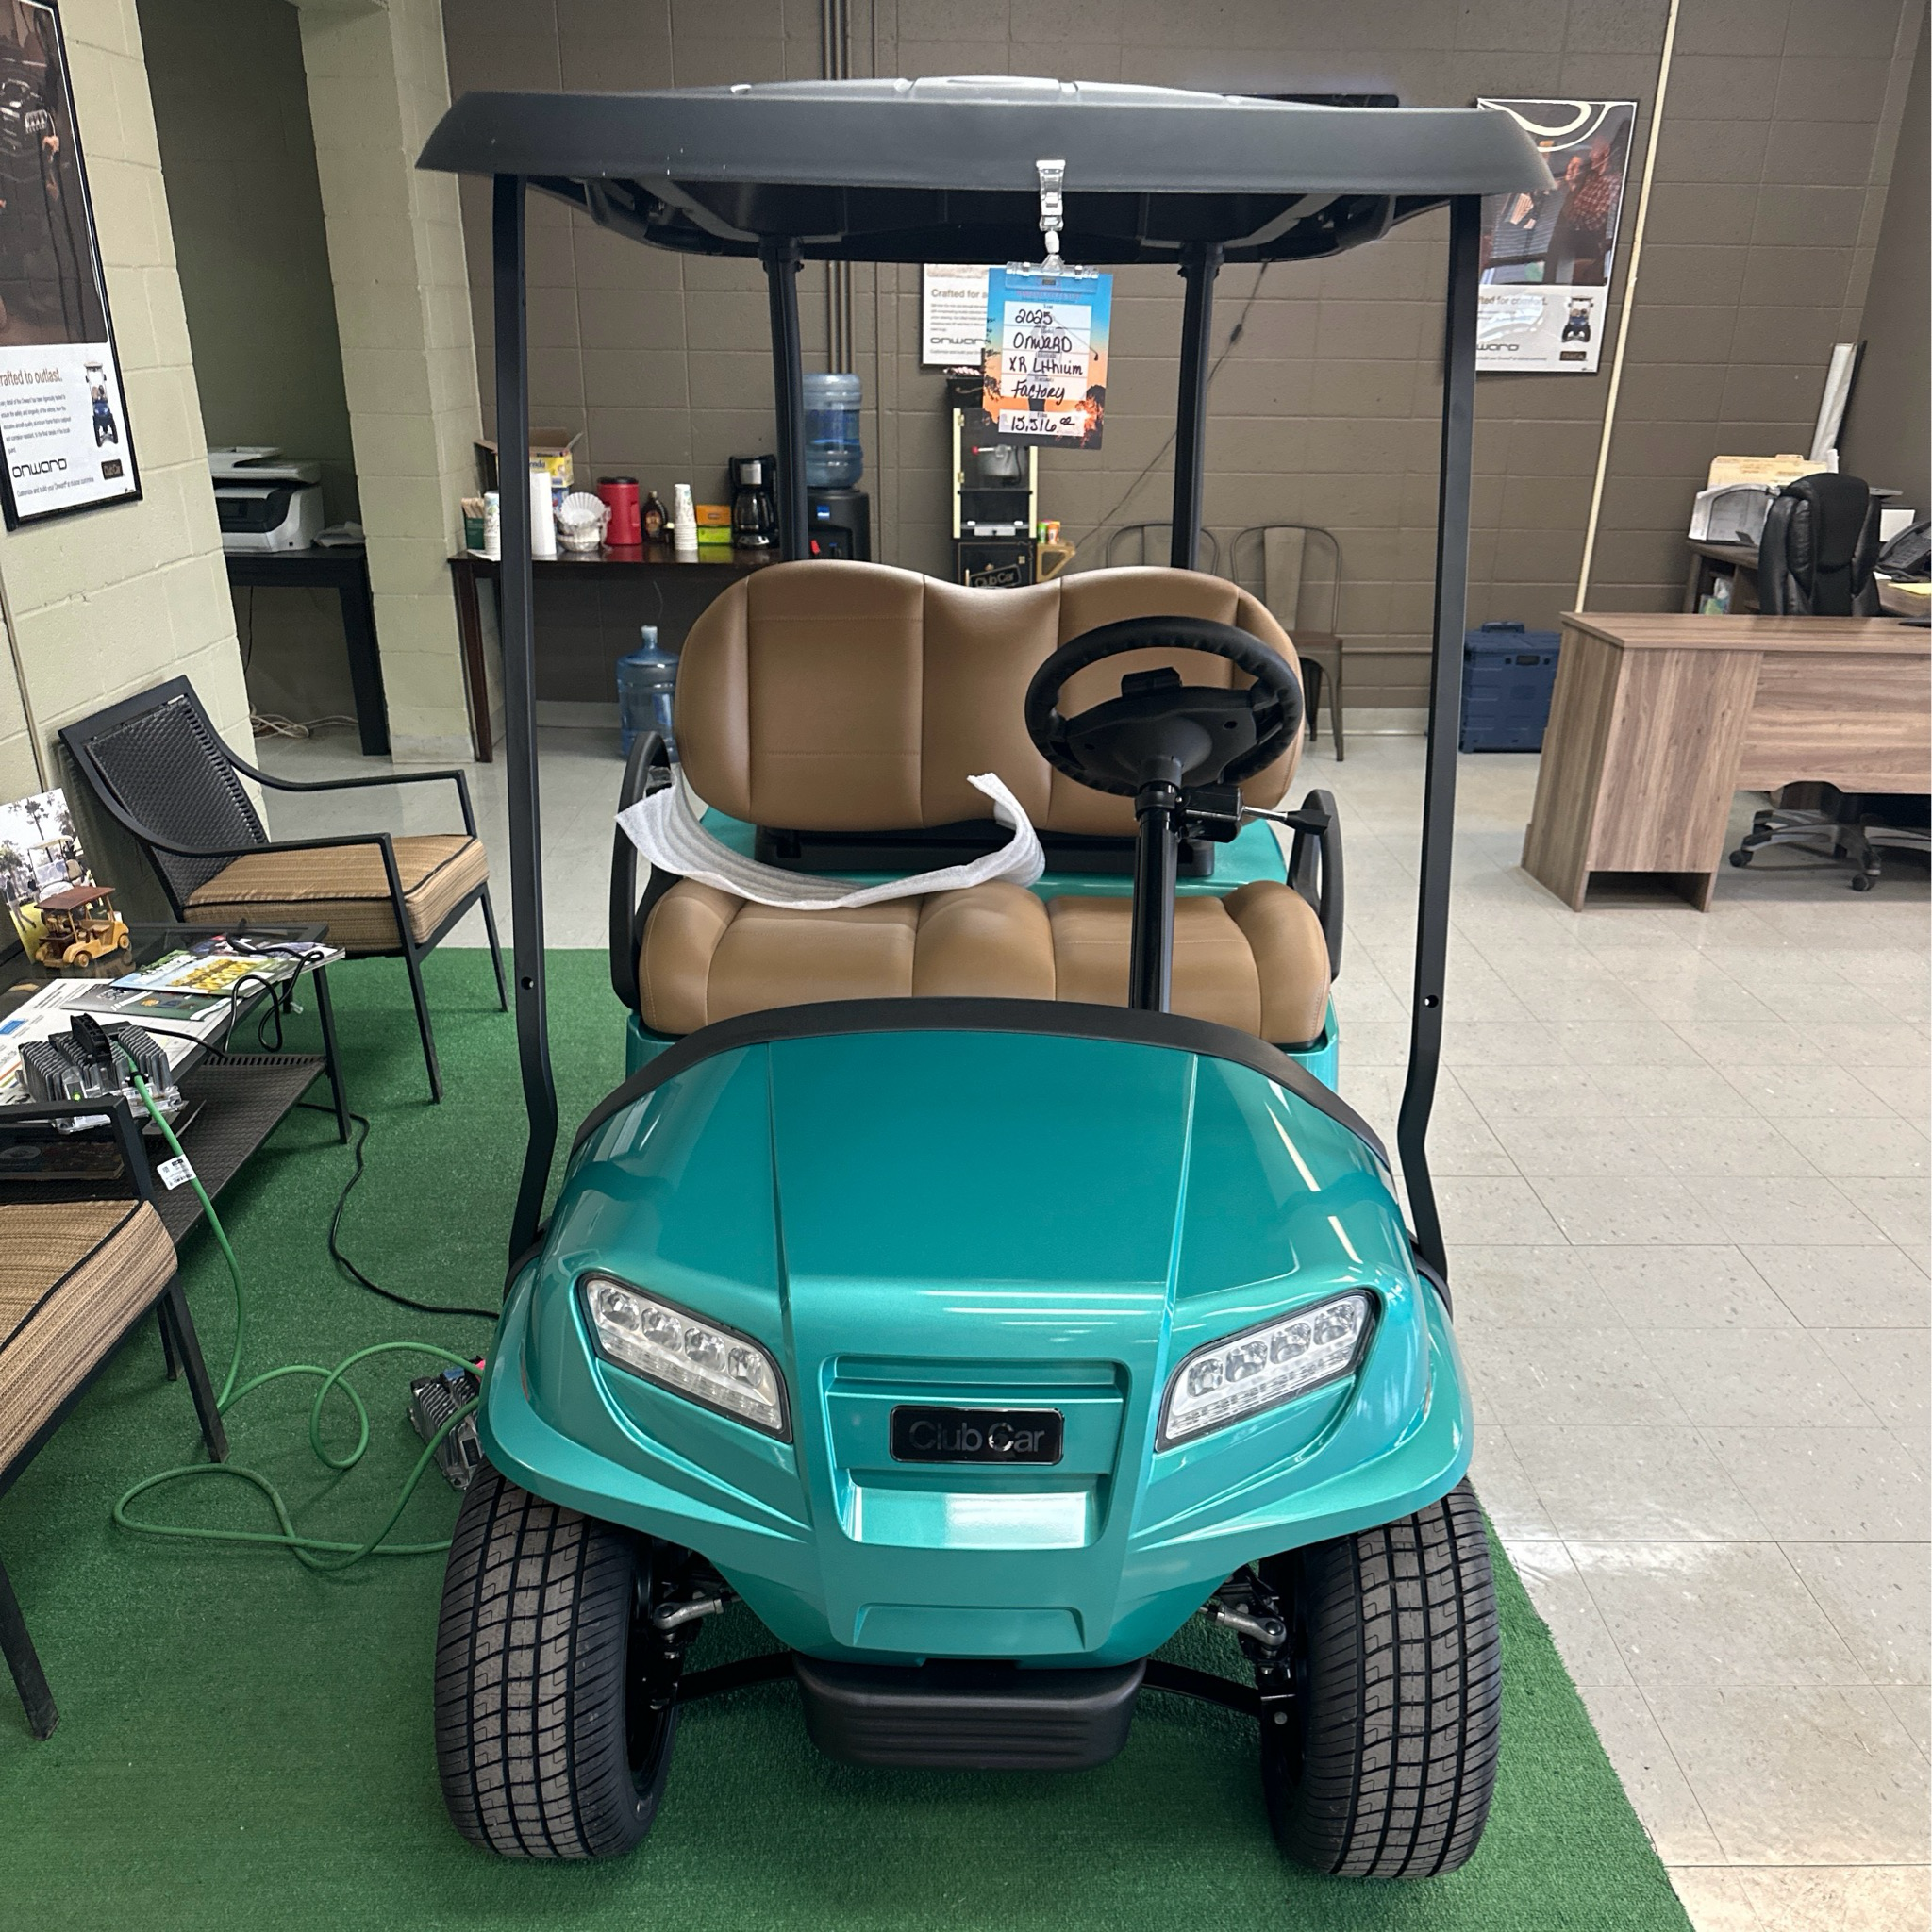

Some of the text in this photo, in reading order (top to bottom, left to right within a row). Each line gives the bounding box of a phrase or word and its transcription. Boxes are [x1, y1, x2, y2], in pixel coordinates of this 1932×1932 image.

[931, 288, 965, 298] Crafted
[967, 290, 980, 298] for
[1015, 308, 1053, 325] 2025
[1009, 356, 1027, 374] XR
[25, 369, 34, 385] to
[35, 367, 63, 384] outlast.
[12, 458, 67, 478] onward
[997, 572, 1014, 583] Car
[909, 1420, 1045, 1453] Club Car
